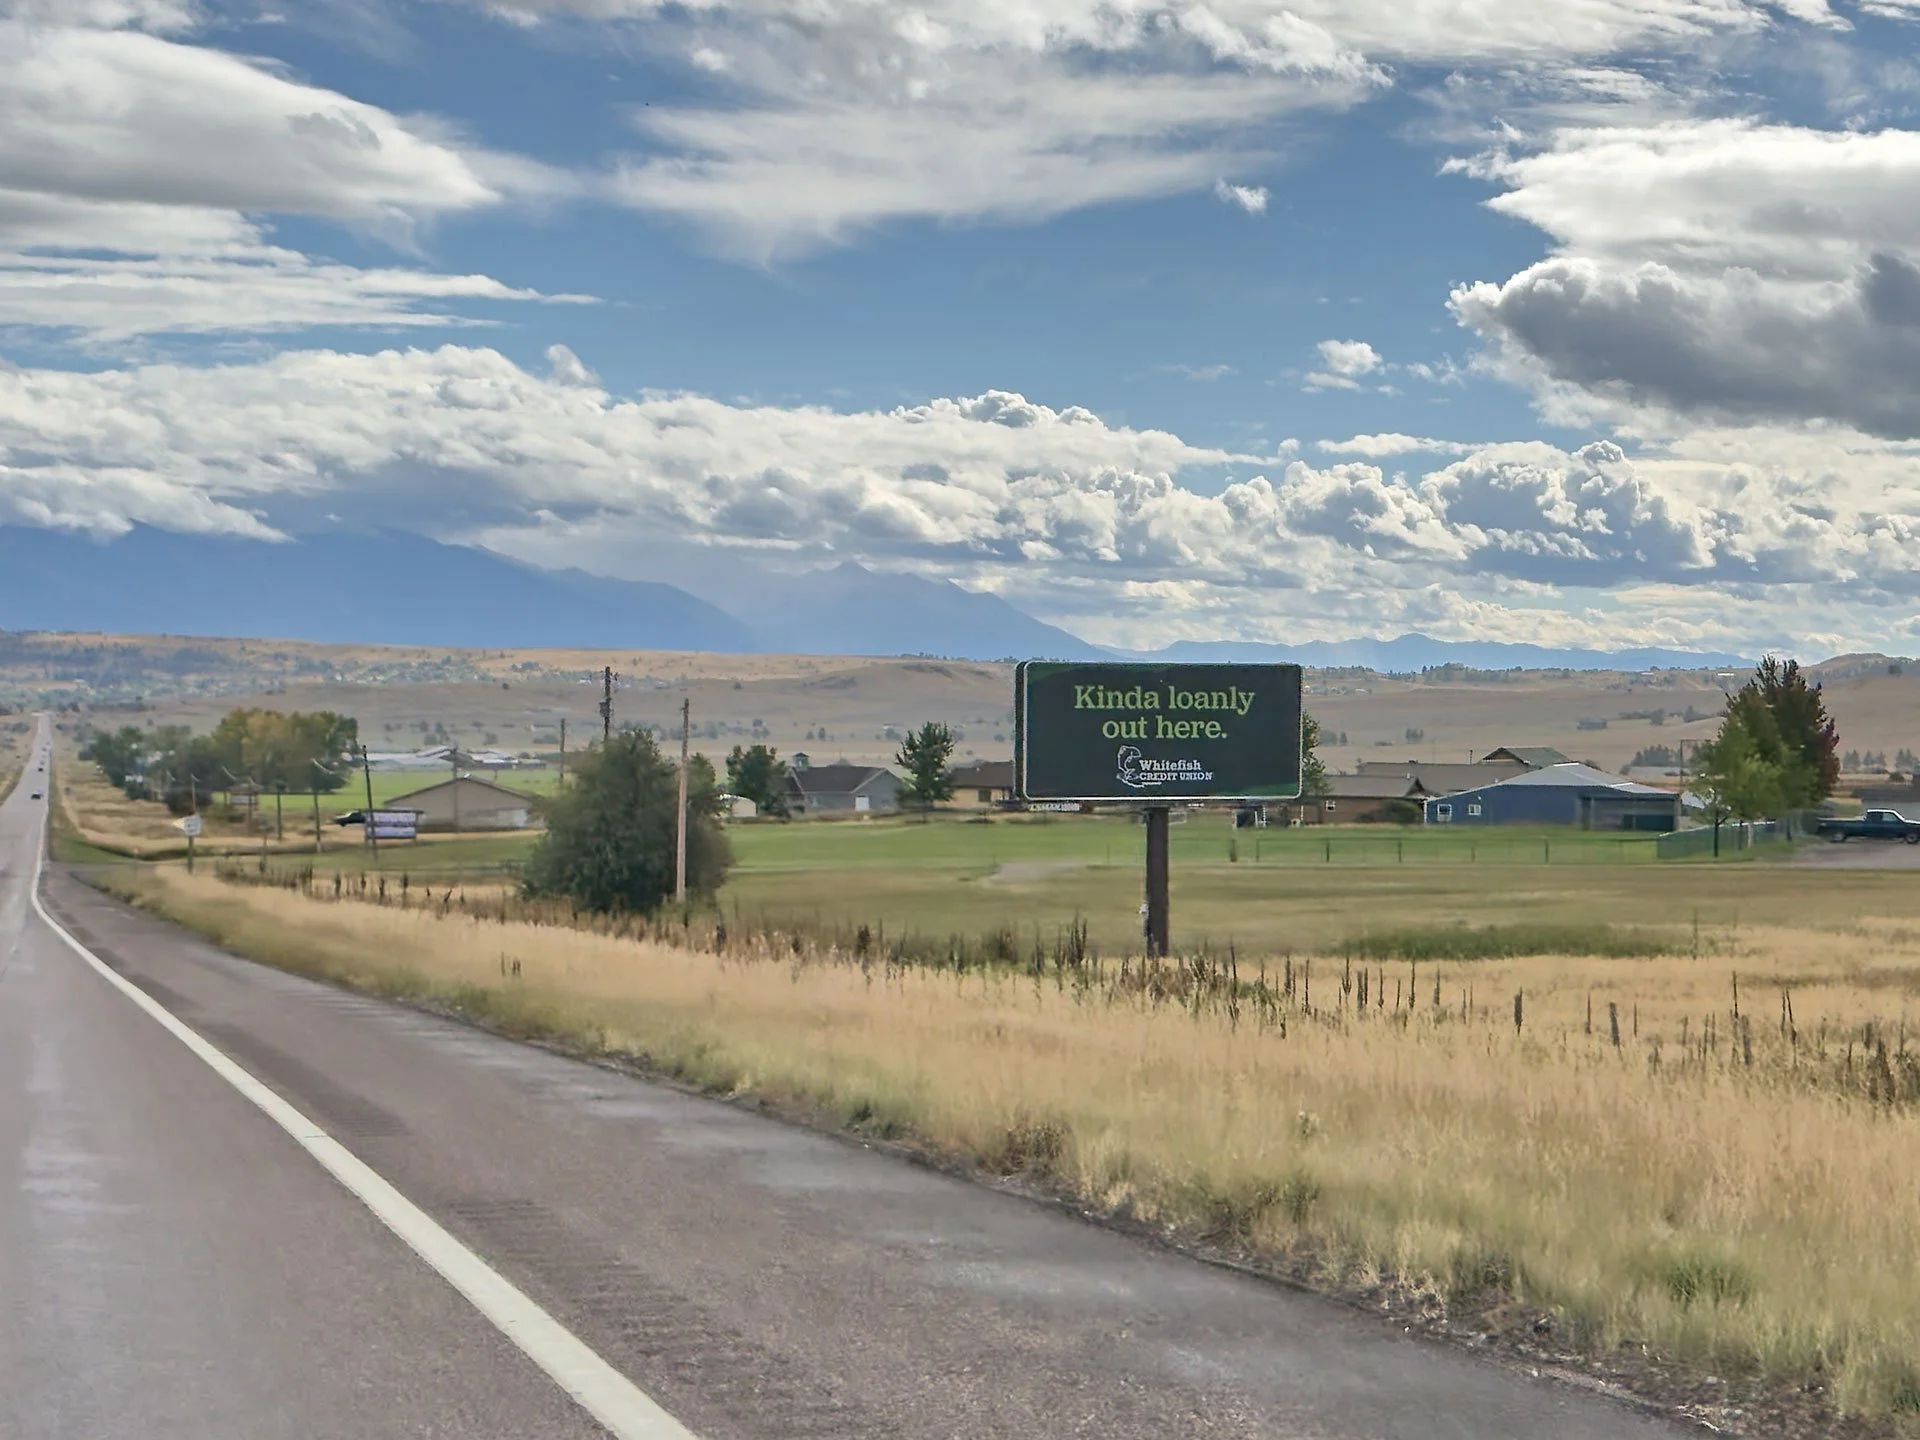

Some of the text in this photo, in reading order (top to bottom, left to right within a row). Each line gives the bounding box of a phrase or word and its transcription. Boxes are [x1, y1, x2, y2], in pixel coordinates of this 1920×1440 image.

[1074, 685, 1255, 715] Kinda loanly
[1102, 715, 1228, 739] out here.
[1139, 759, 1202, 771] Whitefish
[1139, 772, 1213, 781] CREDIT UNION
